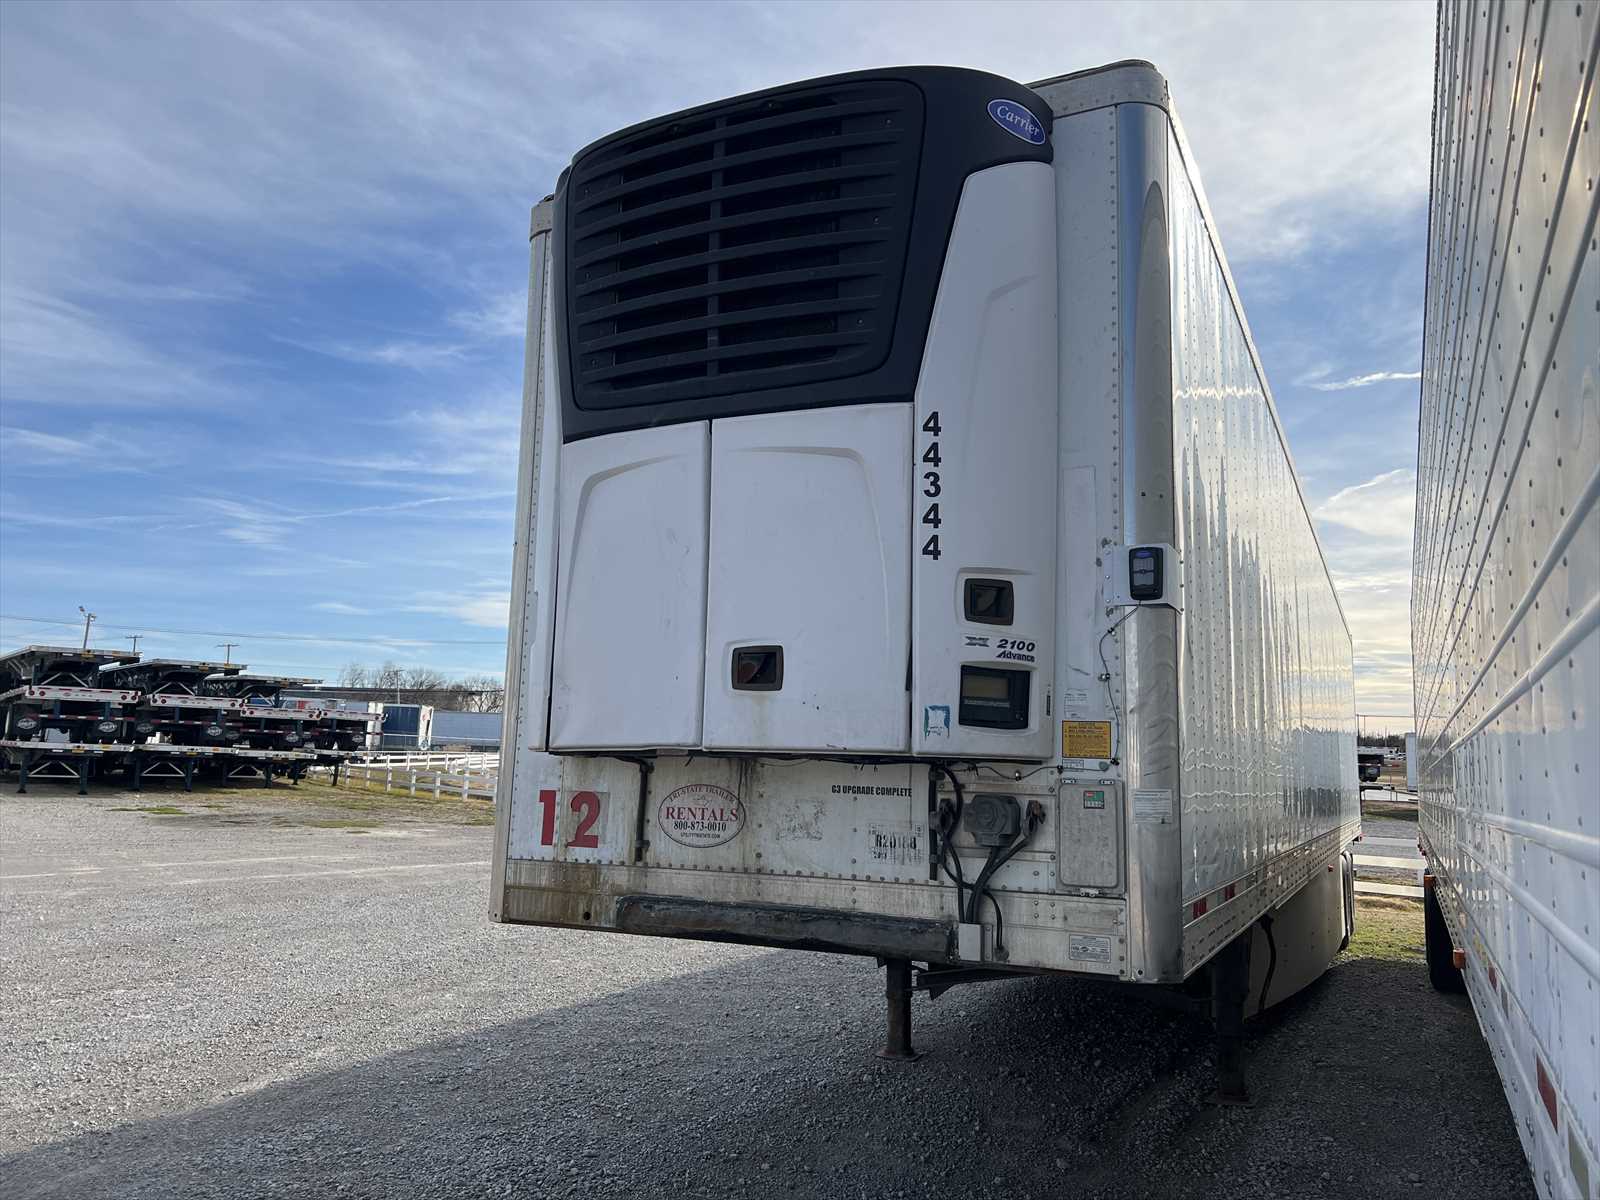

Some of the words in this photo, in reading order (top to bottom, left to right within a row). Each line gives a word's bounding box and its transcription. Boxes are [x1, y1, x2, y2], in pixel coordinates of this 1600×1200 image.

[997, 105, 1040, 136] Carrier
[997, 638, 1036, 652] 2100
[996, 650, 1035, 662] Advance
[669, 786, 704, 802] TRI-STATE
[705, 786, 735, 803] TRAILER
[842, 785, 875, 796] UPGRADE
[875, 786, 912, 797] COMPLETE
[539, 789, 601, 849] 12
[665, 806, 739, 822] RENTALS
[673, 820, 727, 832] 800-873-0010
